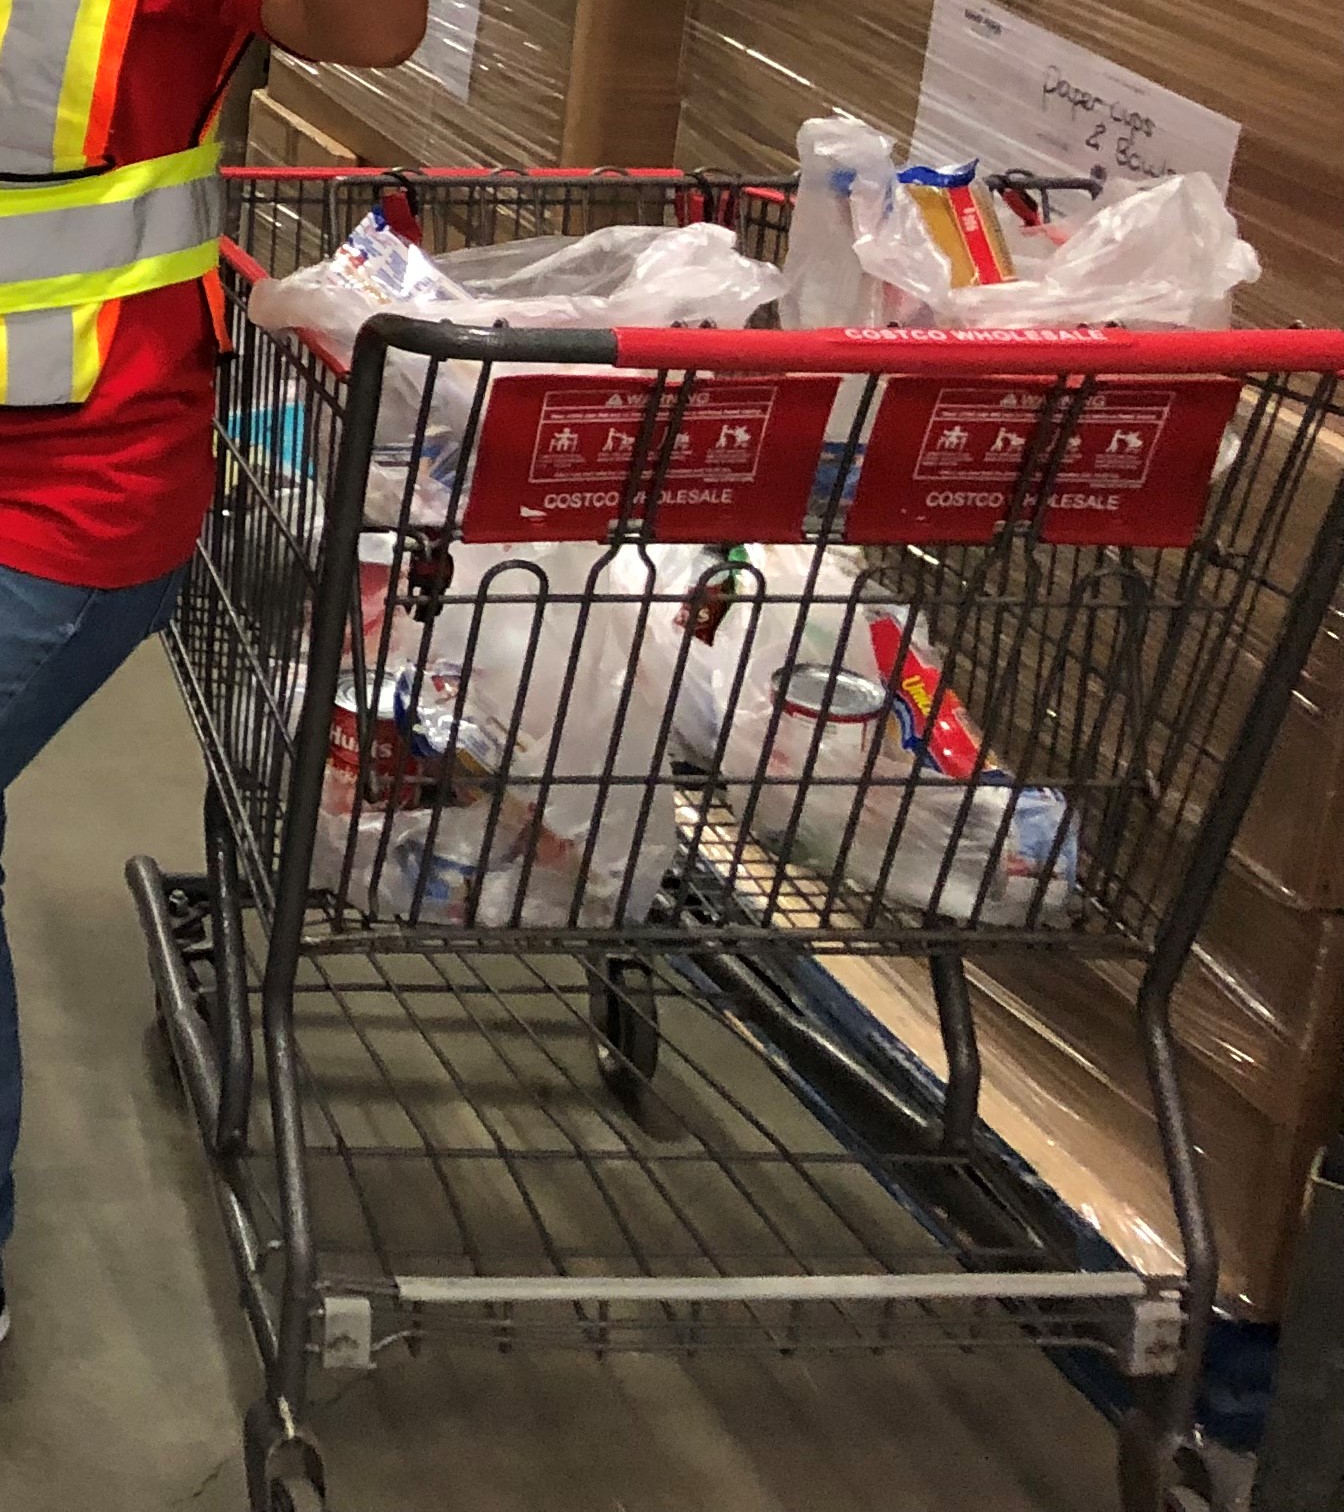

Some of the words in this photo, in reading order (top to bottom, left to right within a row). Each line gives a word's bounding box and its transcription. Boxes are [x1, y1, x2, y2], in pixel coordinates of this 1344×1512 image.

[845, 328, 948, 342] COSTCO
[951, 329, 1108, 344] WHOLESALE
[544, 491, 620, 509] COSTCO
[926, 492, 1004, 508] COSTCO
